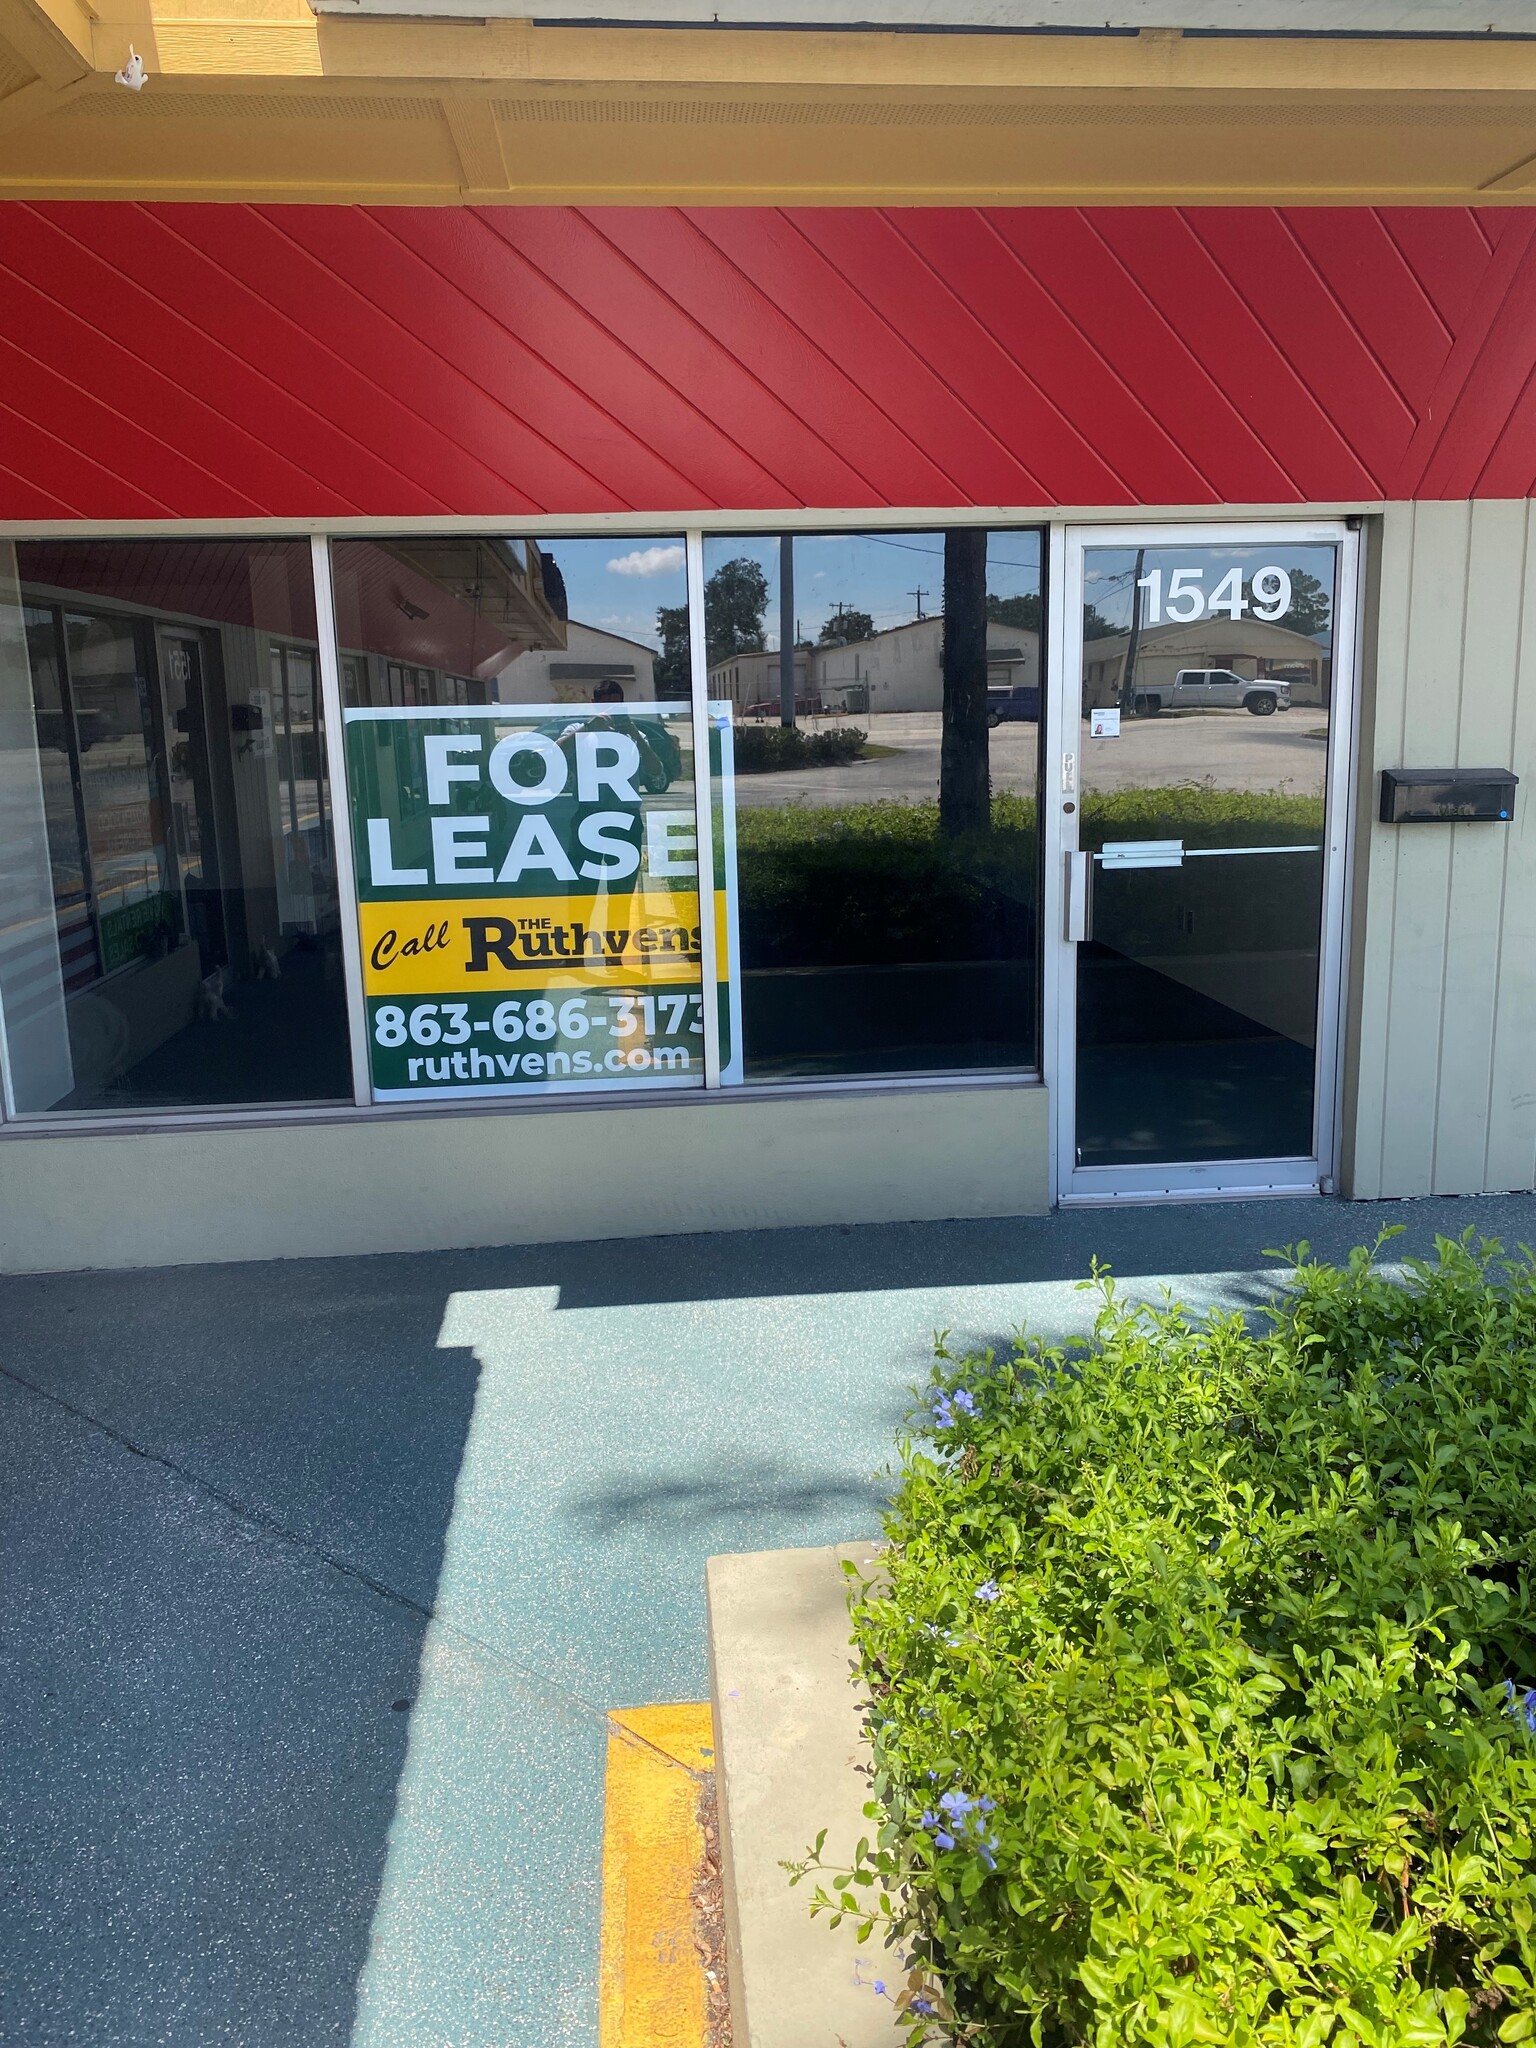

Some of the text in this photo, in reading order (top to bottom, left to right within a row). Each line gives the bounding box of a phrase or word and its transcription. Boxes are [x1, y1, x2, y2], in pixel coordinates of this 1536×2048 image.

[1137, 565, 1292, 622] 1549
[424, 731, 643, 805] FOR
[367, 810, 698, 887] LEASE
[370, 920, 450, 971] Call
[517, 918, 552, 930] THE
[407, 1044, 690, 1081] ruthvens.com
